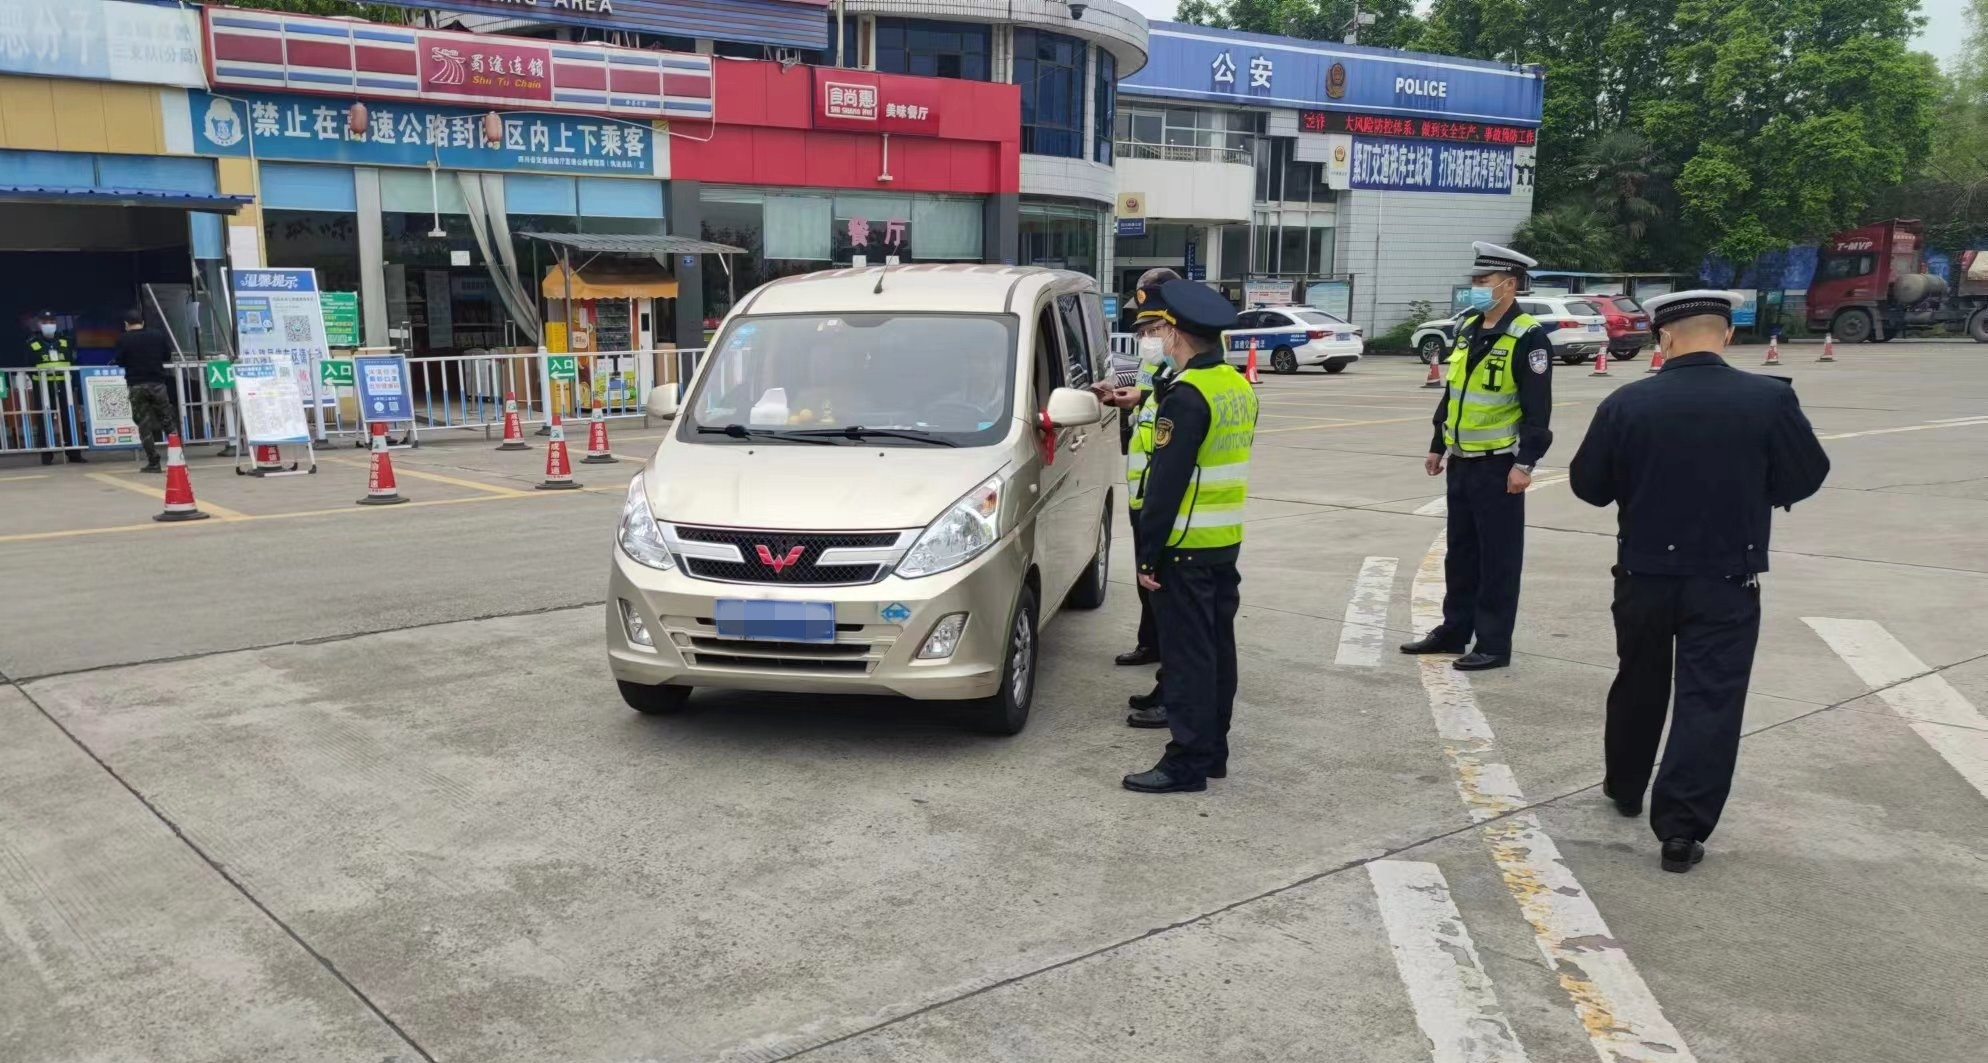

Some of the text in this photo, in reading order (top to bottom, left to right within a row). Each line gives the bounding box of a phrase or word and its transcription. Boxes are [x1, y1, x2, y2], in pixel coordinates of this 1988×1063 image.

[1212, 53, 1272, 88] 公安
[515, 79, 542, 88] Chain
[1395, 77, 1447, 98] POLICE
[886, 103, 929, 120] 美味餐厅
[848, 216, 906, 248] 餐厅
[1837, 241, 1873, 251] T-MVP
[325, 364, 352, 377] 入口
[551, 359, 574, 370] 入口
[550, 442, 561, 476] 成渝高速
